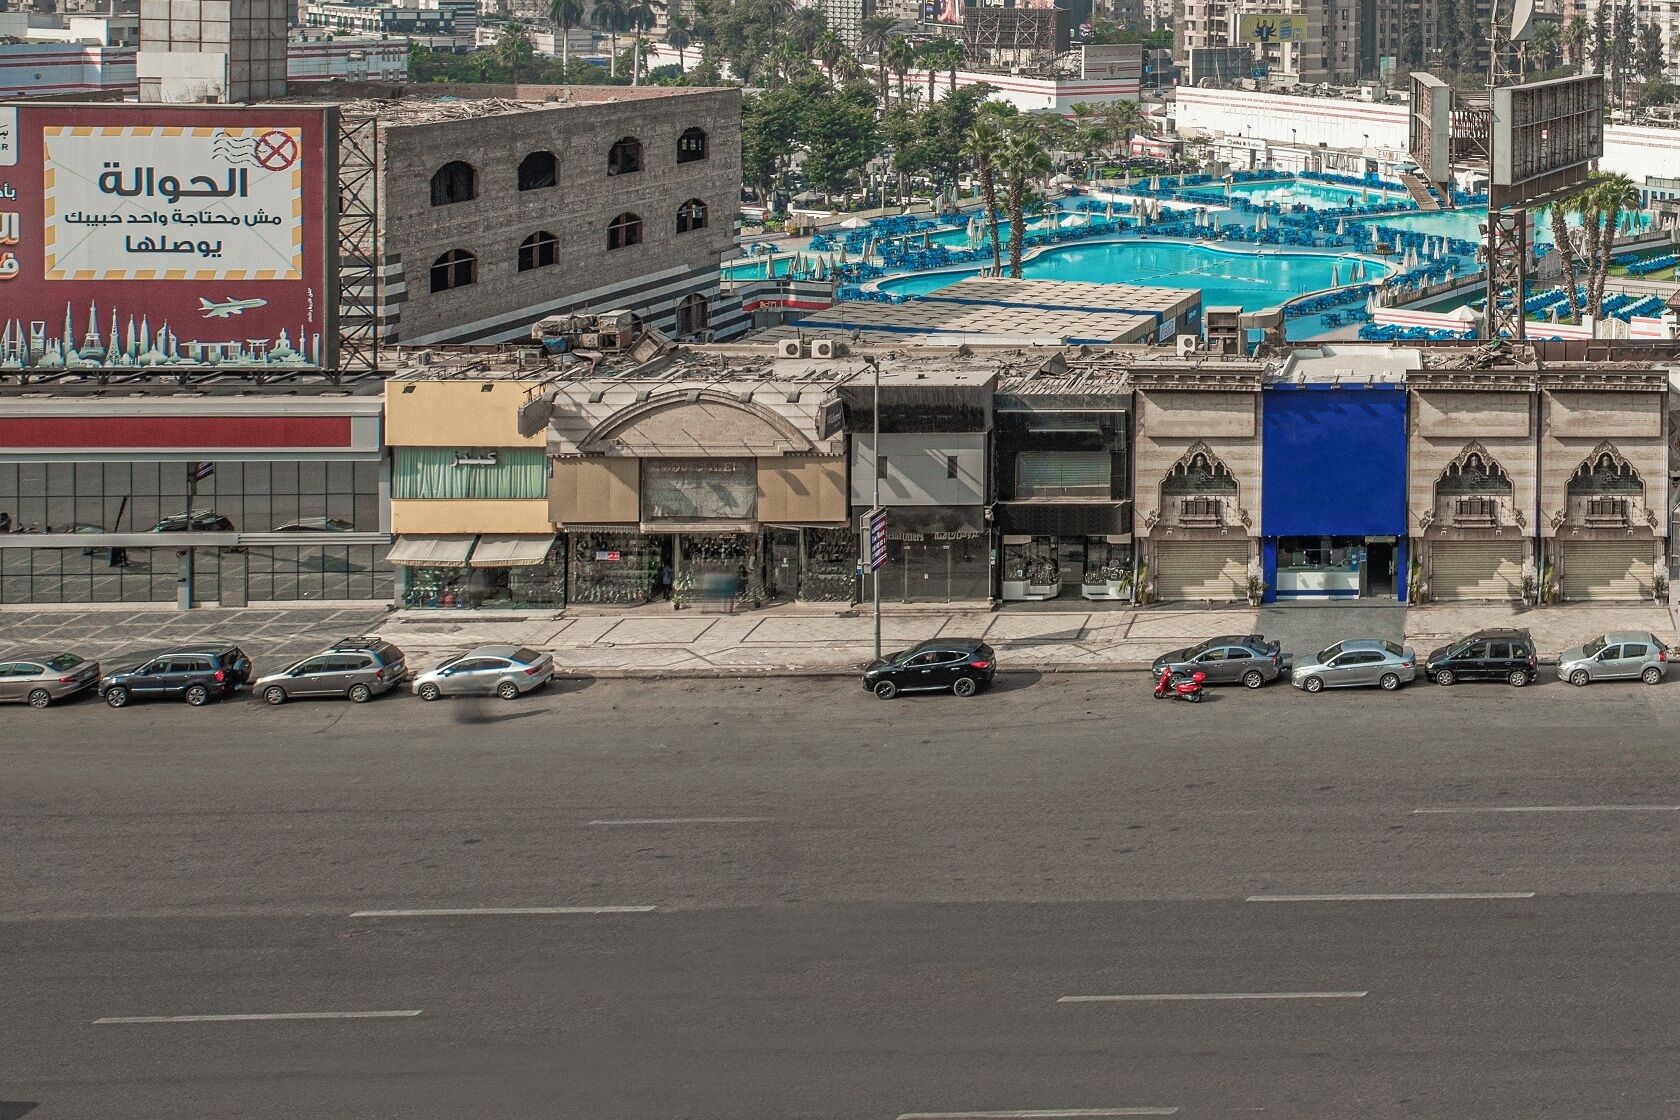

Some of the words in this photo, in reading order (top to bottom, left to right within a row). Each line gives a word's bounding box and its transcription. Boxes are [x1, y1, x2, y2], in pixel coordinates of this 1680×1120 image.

[98, 161, 248, 204] الحوالة
[64, 210, 122, 227] حبيبك
[127, 211, 168, 227] واحد
[172, 209, 241, 227] محتاجة
[244, 209, 282, 226] مش
[125, 235, 223, 258] يوصلها
